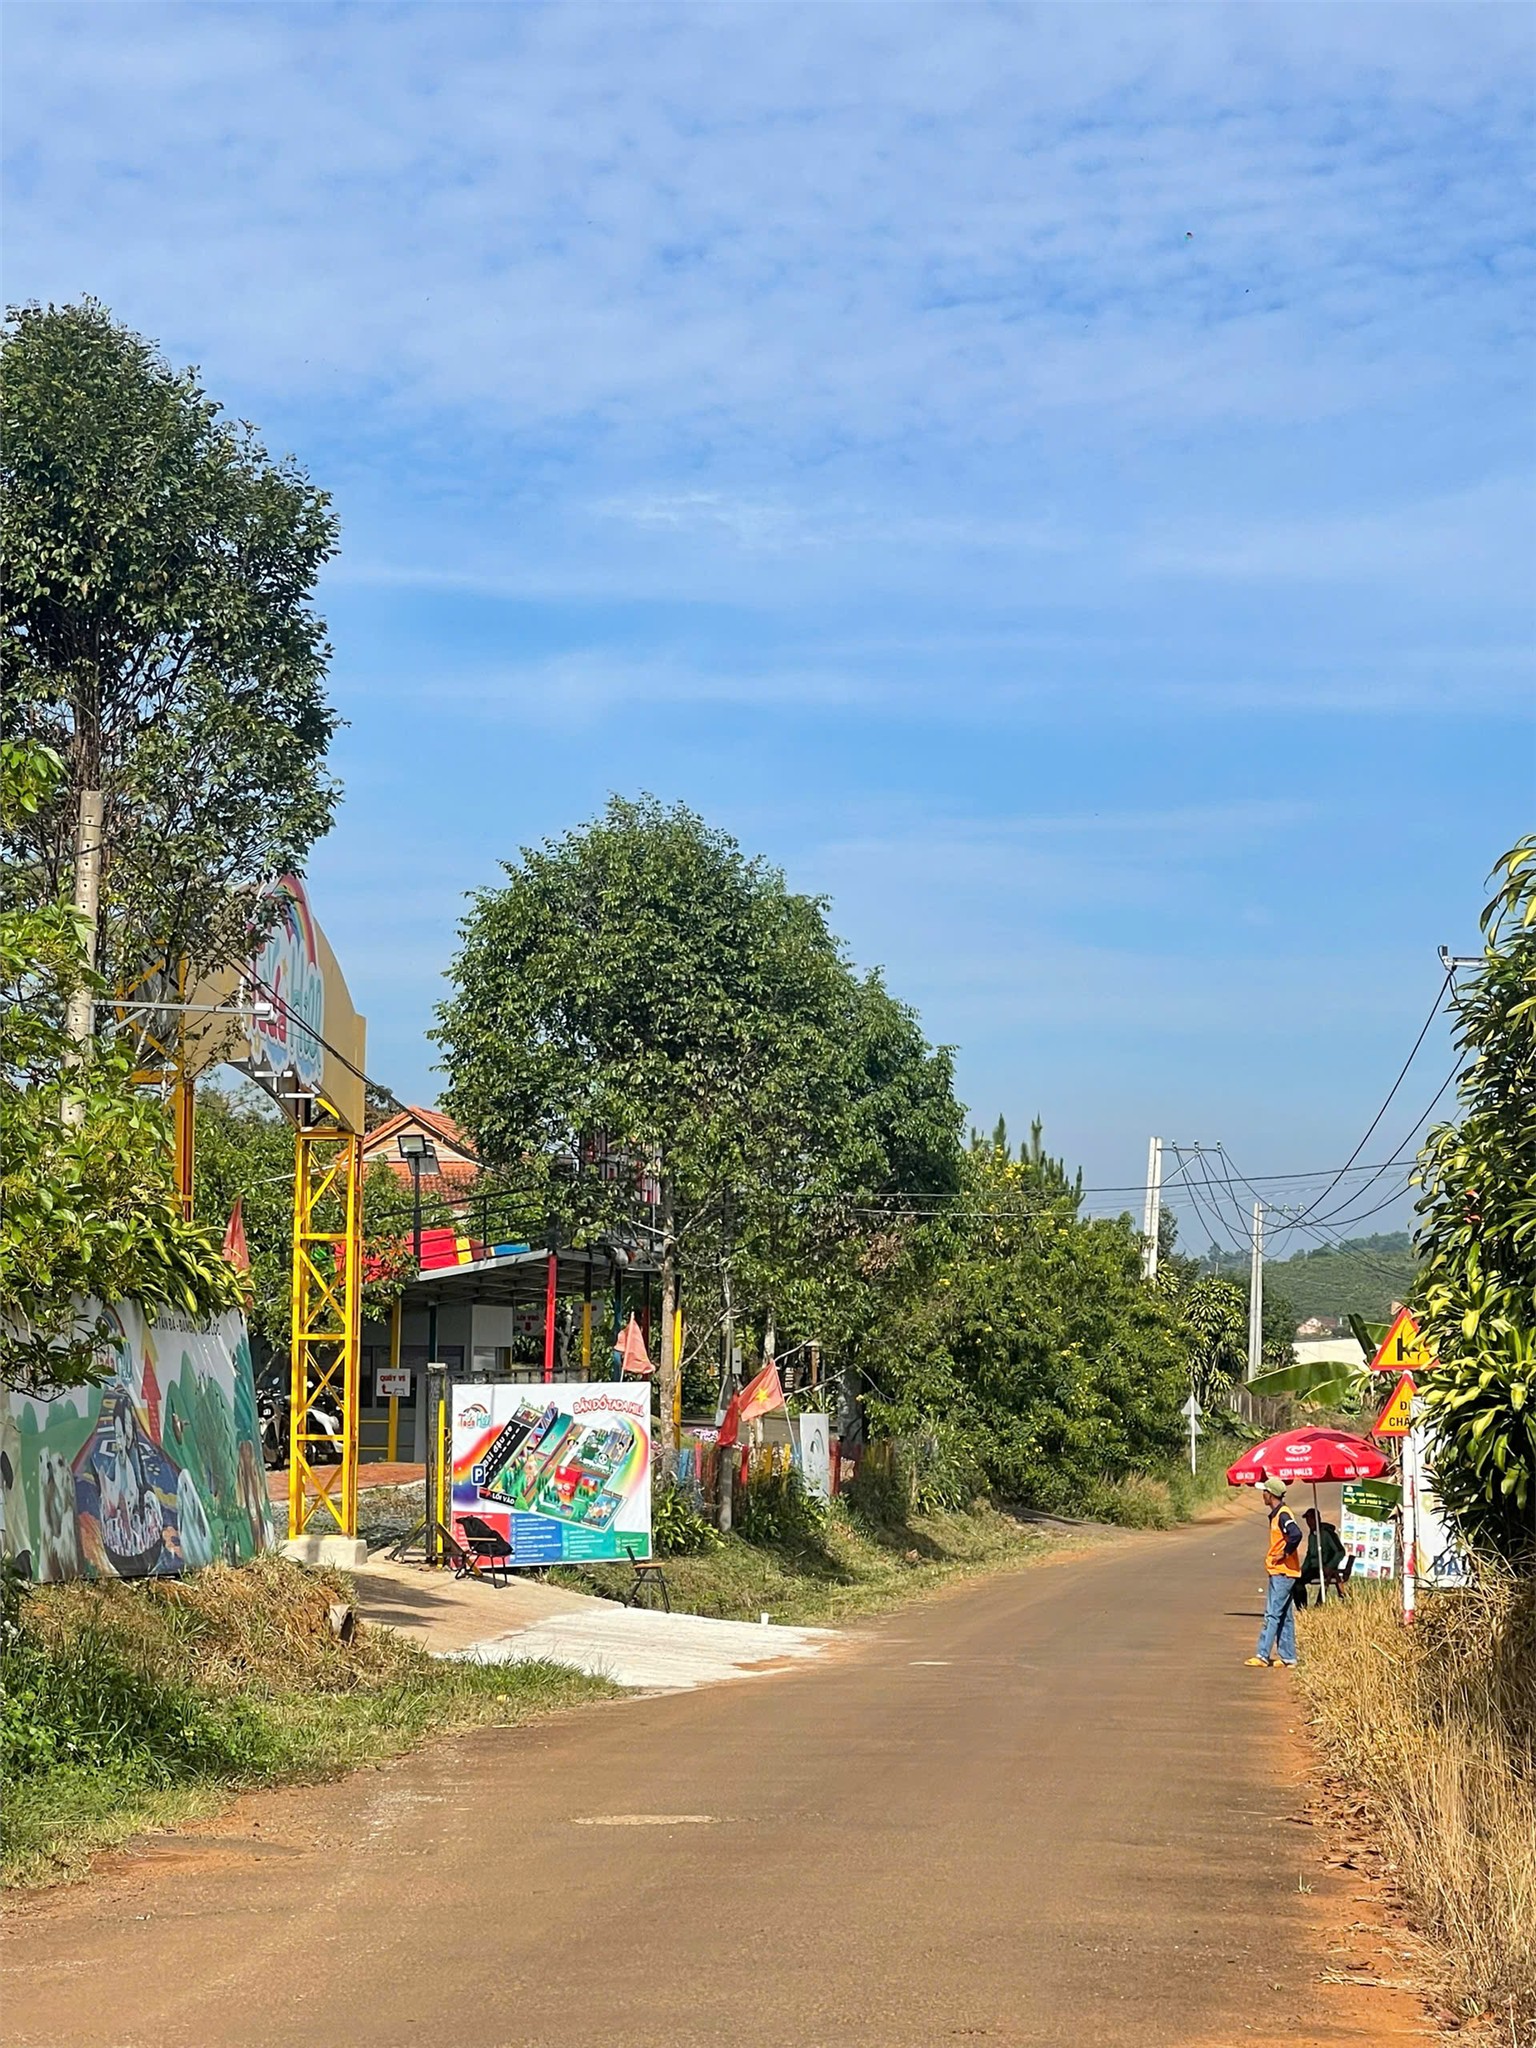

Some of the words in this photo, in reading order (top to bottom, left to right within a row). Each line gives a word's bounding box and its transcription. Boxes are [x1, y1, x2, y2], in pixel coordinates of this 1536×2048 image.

[608, 1399, 628, 1413] TADA
[628, 1401, 644, 1417] HILL
[474, 1468, 483, 1481] P
[1280, 1468, 1293, 1476] KEM
